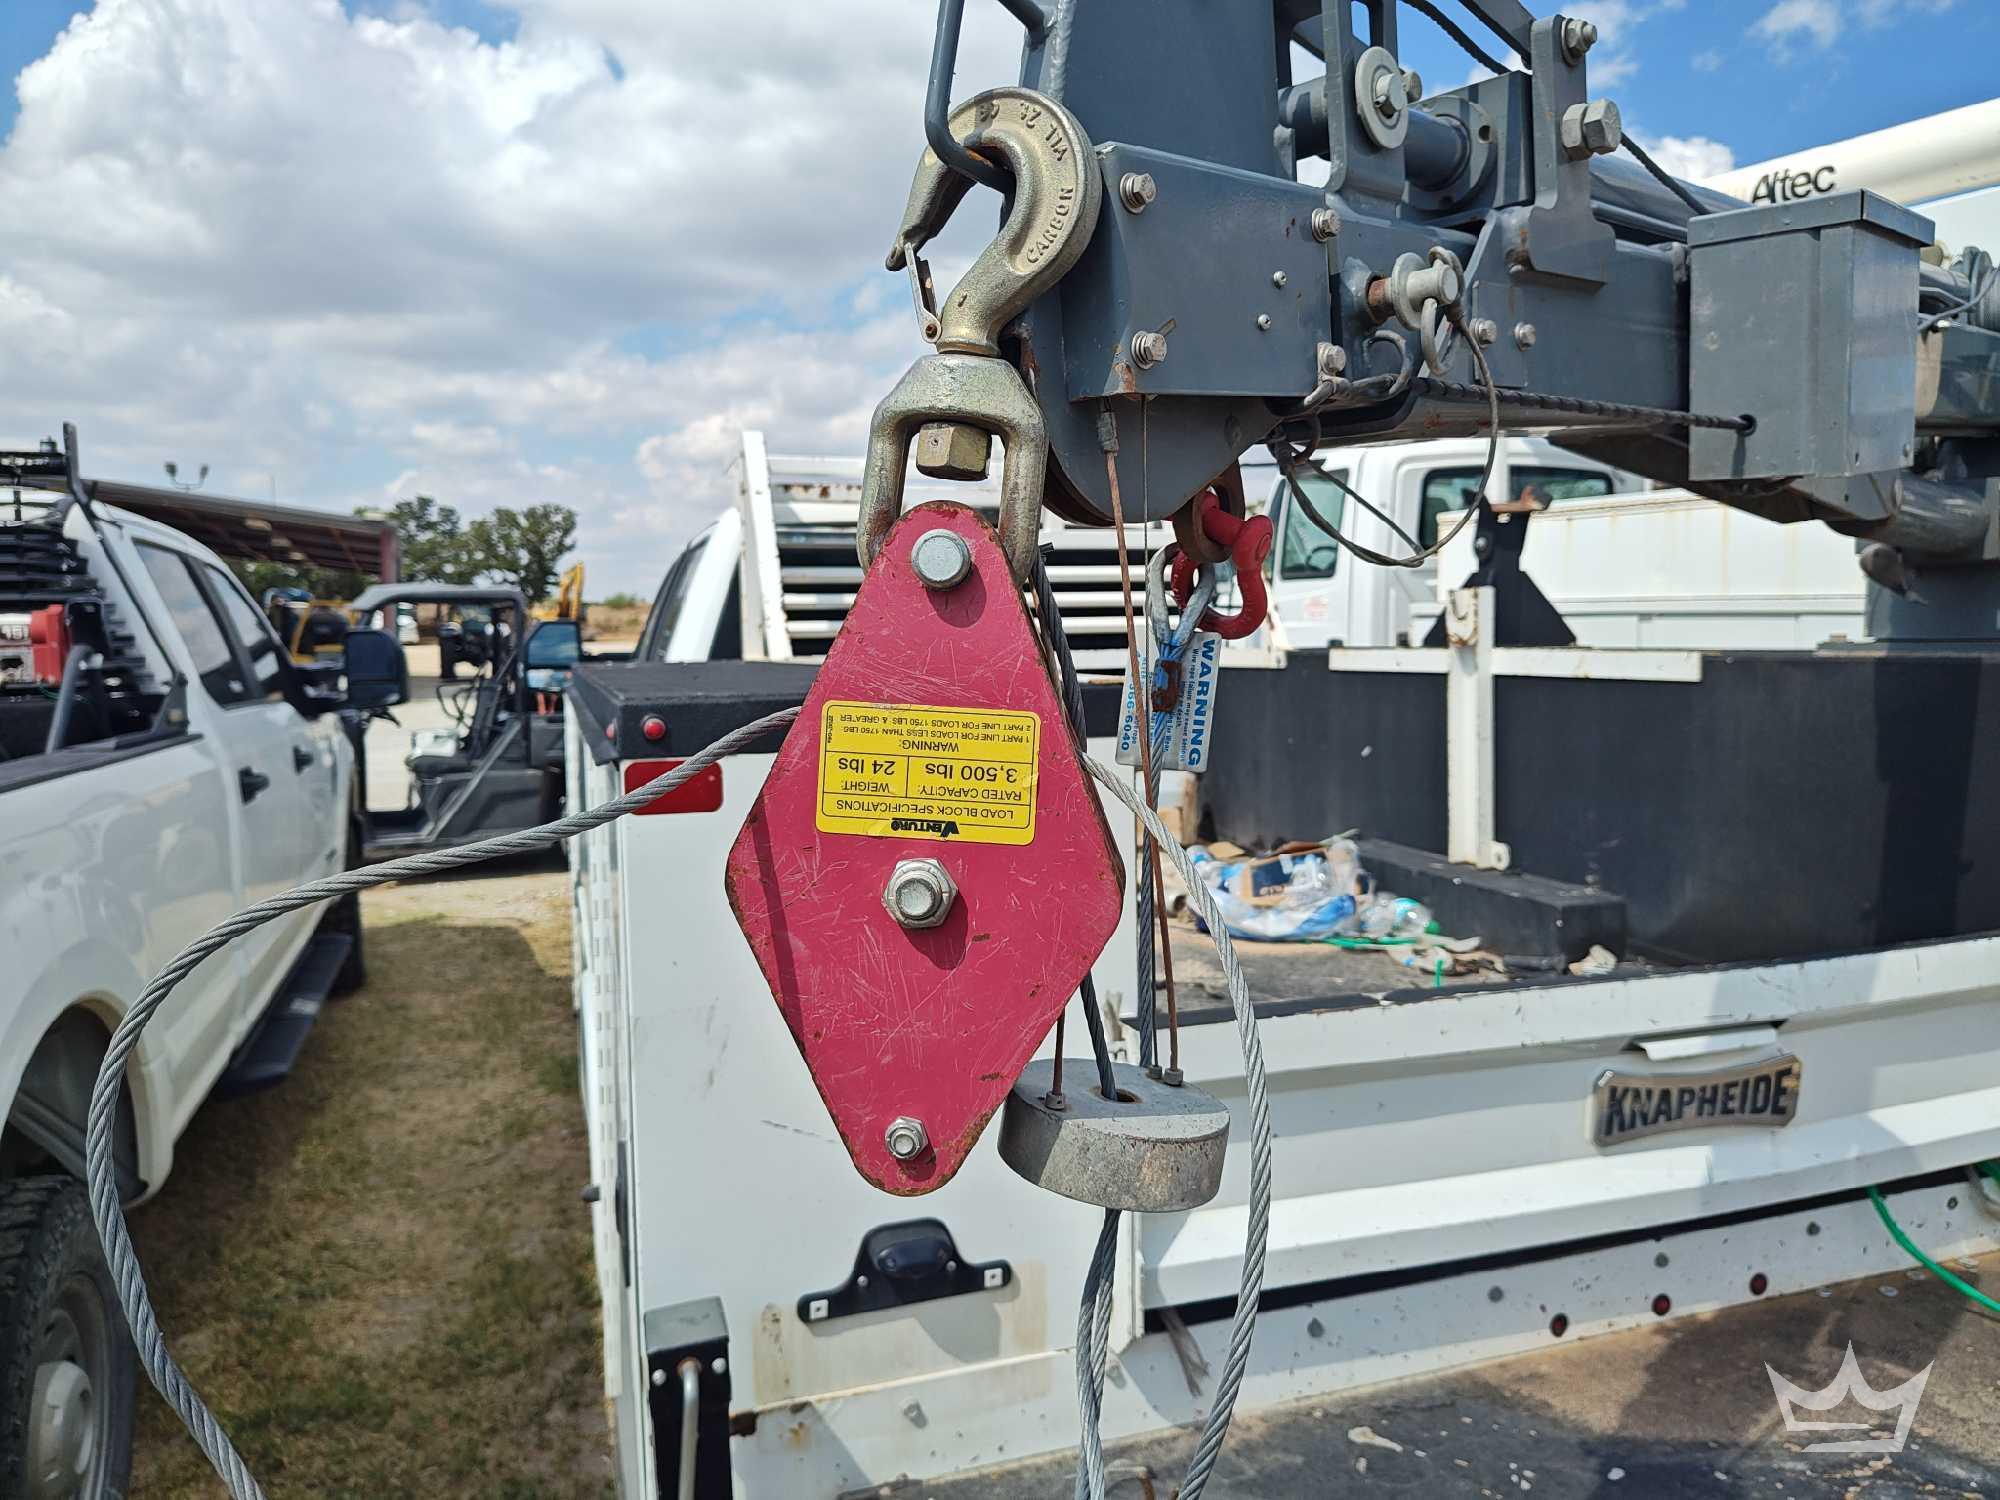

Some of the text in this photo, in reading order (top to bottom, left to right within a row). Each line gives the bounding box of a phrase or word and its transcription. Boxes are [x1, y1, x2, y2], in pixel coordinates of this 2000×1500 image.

[1752, 166, 1835, 204] Altec
[1188, 639, 1216, 767] WARNING
[840, 714, 880, 723] GREATER
[909, 718, 929, 726] 1750
[932, 719, 960, 728] LOADS
[961, 721, 980, 729] FOR
[981, 722, 1001, 730] LINE
[1003, 724, 1024, 732] PART
[882, 728, 904, 736] THAN
[906, 729, 929, 737] LESS
[931, 731, 959, 739] LOADS
[961, 732, 979, 741] FOR
[981, 733, 1000, 741] LINE
[1002, 735, 1023, 743] PART
[898, 738, 959, 752] WARNING:
[838, 757, 896, 776] 24 lbs
[924, 763, 1018, 784] 3,500 lbs
[841, 780, 890, 793] WEIGHT:
[918, 784, 1022, 801] RATED CAPACITY:
[836, 799, 1014, 819] LOAD BLOCK SPECIFICATIONS
[890, 819, 960, 838] VENTURO
[1604, 1067, 1793, 1136] KNAPHEIDE
